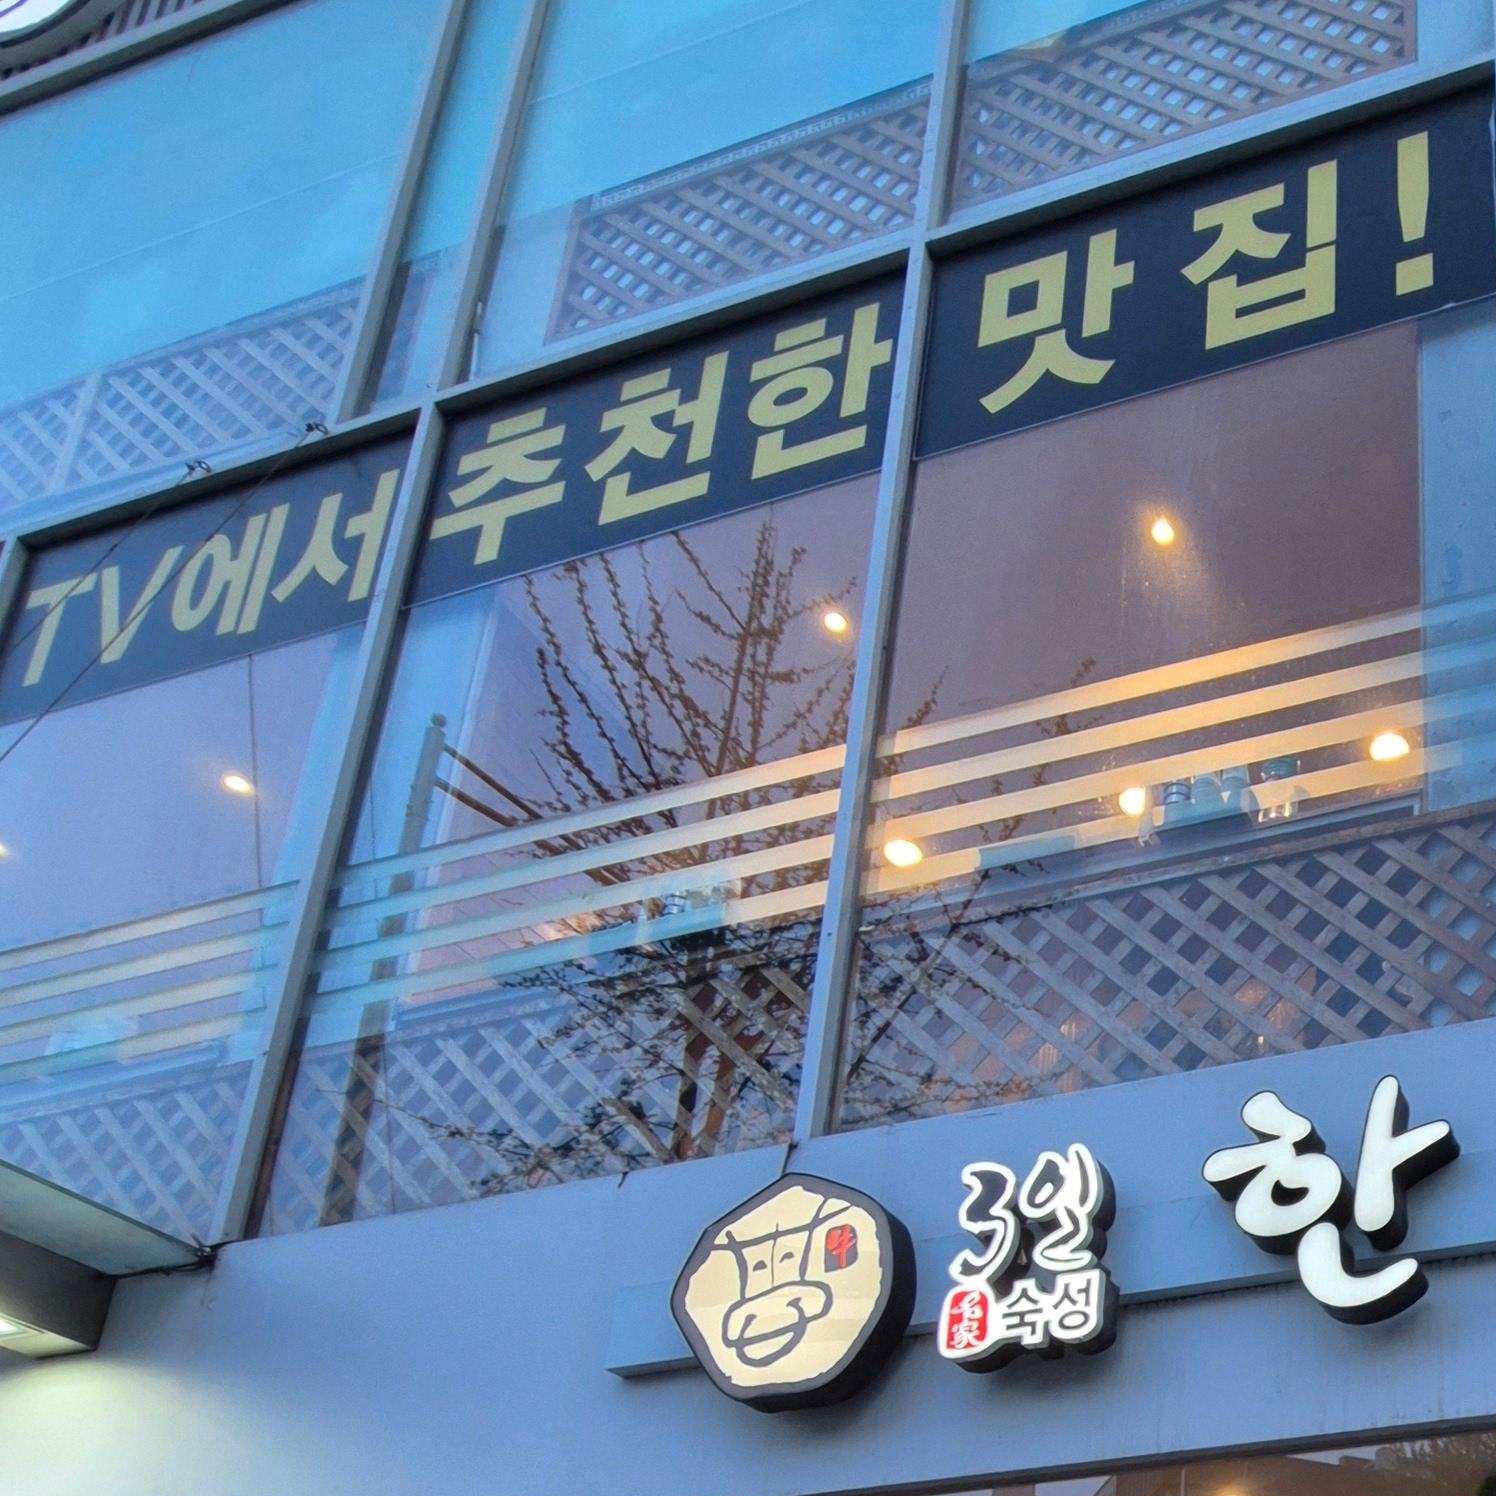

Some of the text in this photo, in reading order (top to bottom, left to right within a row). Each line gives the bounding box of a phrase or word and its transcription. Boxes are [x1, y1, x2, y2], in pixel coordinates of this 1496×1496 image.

[20, 130, 1435, 688] TV에서 추천한 맛집!
[950, 1142, 1098, 1279] 3일
[1001, 1278, 1093, 1338] 숙성
